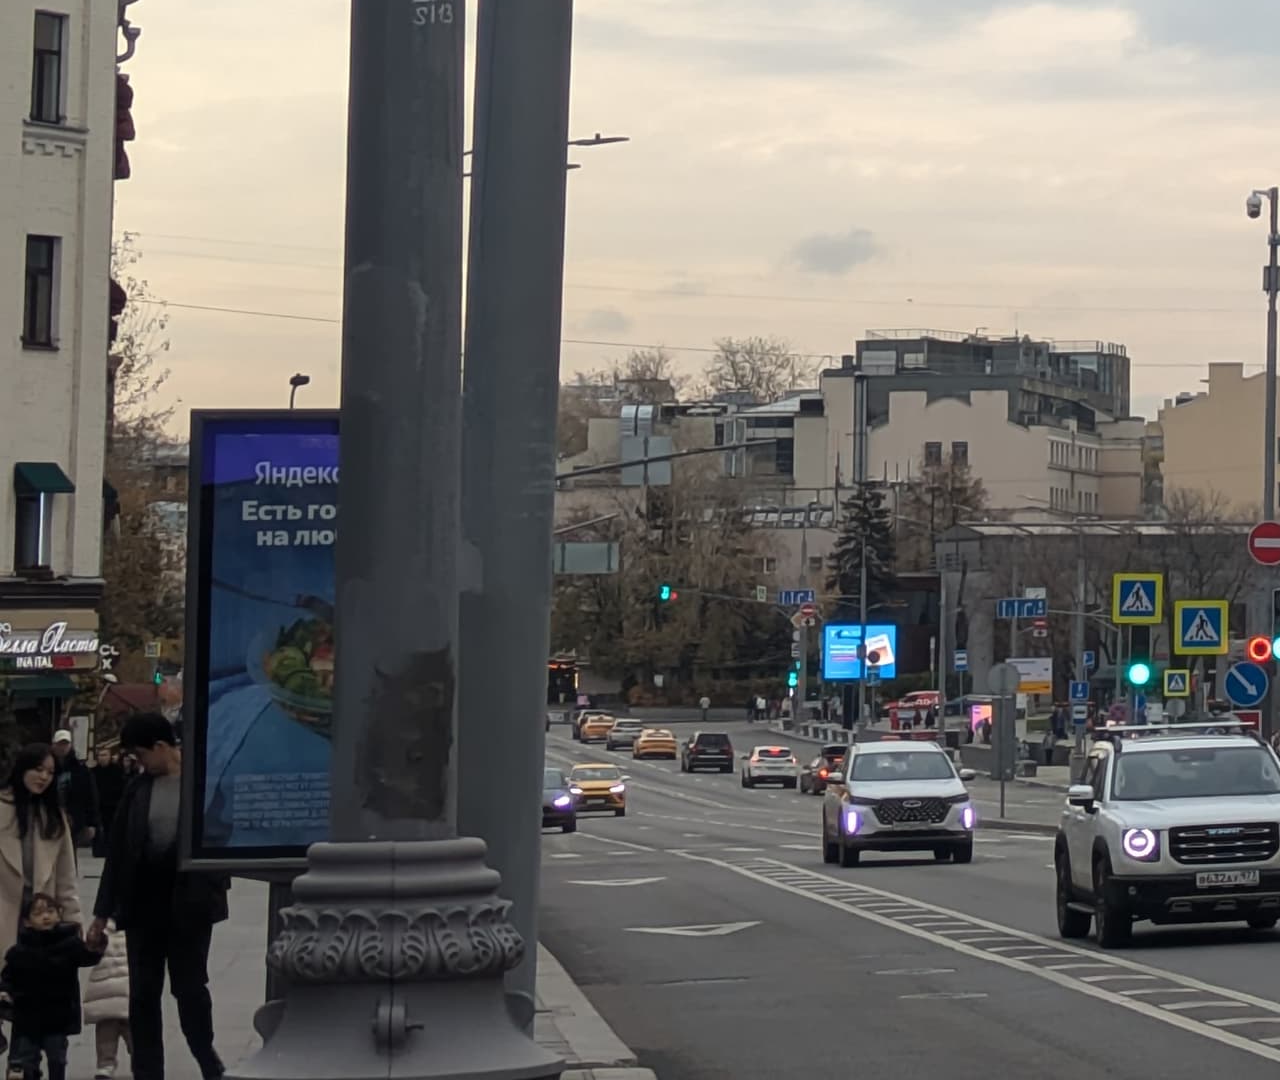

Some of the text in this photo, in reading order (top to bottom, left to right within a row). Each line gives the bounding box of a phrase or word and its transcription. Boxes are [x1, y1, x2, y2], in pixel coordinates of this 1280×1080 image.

[255, 461, 339, 487] Яндекс
[242, 500, 302, 521] Есть
[256, 530, 338, 546] на лю
